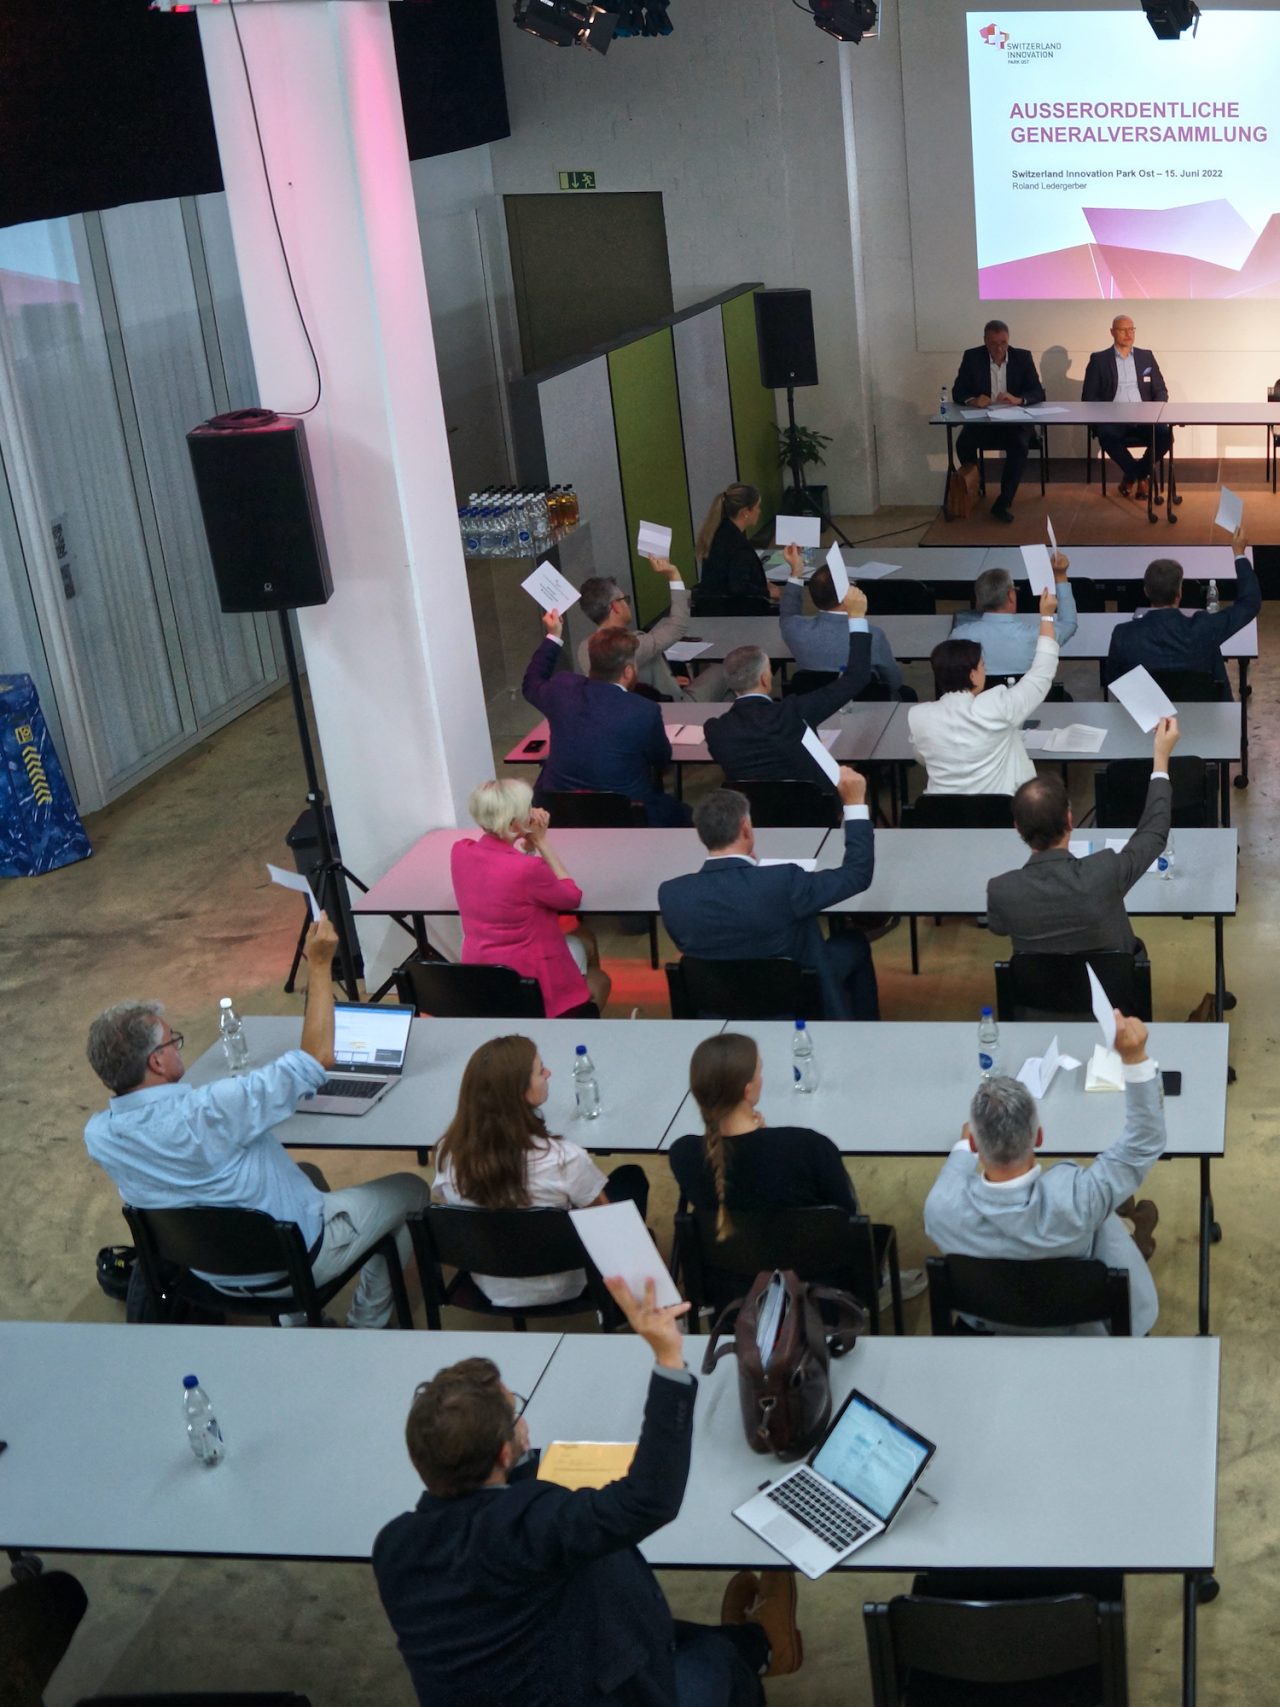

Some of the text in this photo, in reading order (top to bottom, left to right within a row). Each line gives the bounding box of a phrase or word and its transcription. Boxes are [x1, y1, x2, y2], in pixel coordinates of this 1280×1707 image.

[1007, 43, 1062, 51] SWITZERLAND
[1007, 51, 1054, 59] INNOVATION
[1009, 102, 1240, 119] AUSSERORDENTLICHE
[1010, 126, 1268, 143] GENERALVERSAMMLUNG
[1012, 170, 1064, 178] Switzerland
[1066, 170, 1114, 178] Innovation
[1116, 170, 1137, 178] Park
[1139, 170, 1155, 178] Ost
[1165, 170, 1178, 178] 15.
[1180, 170, 1200, 178] Juni
[1012, 182, 1088, 191] Roland Ledergerber
